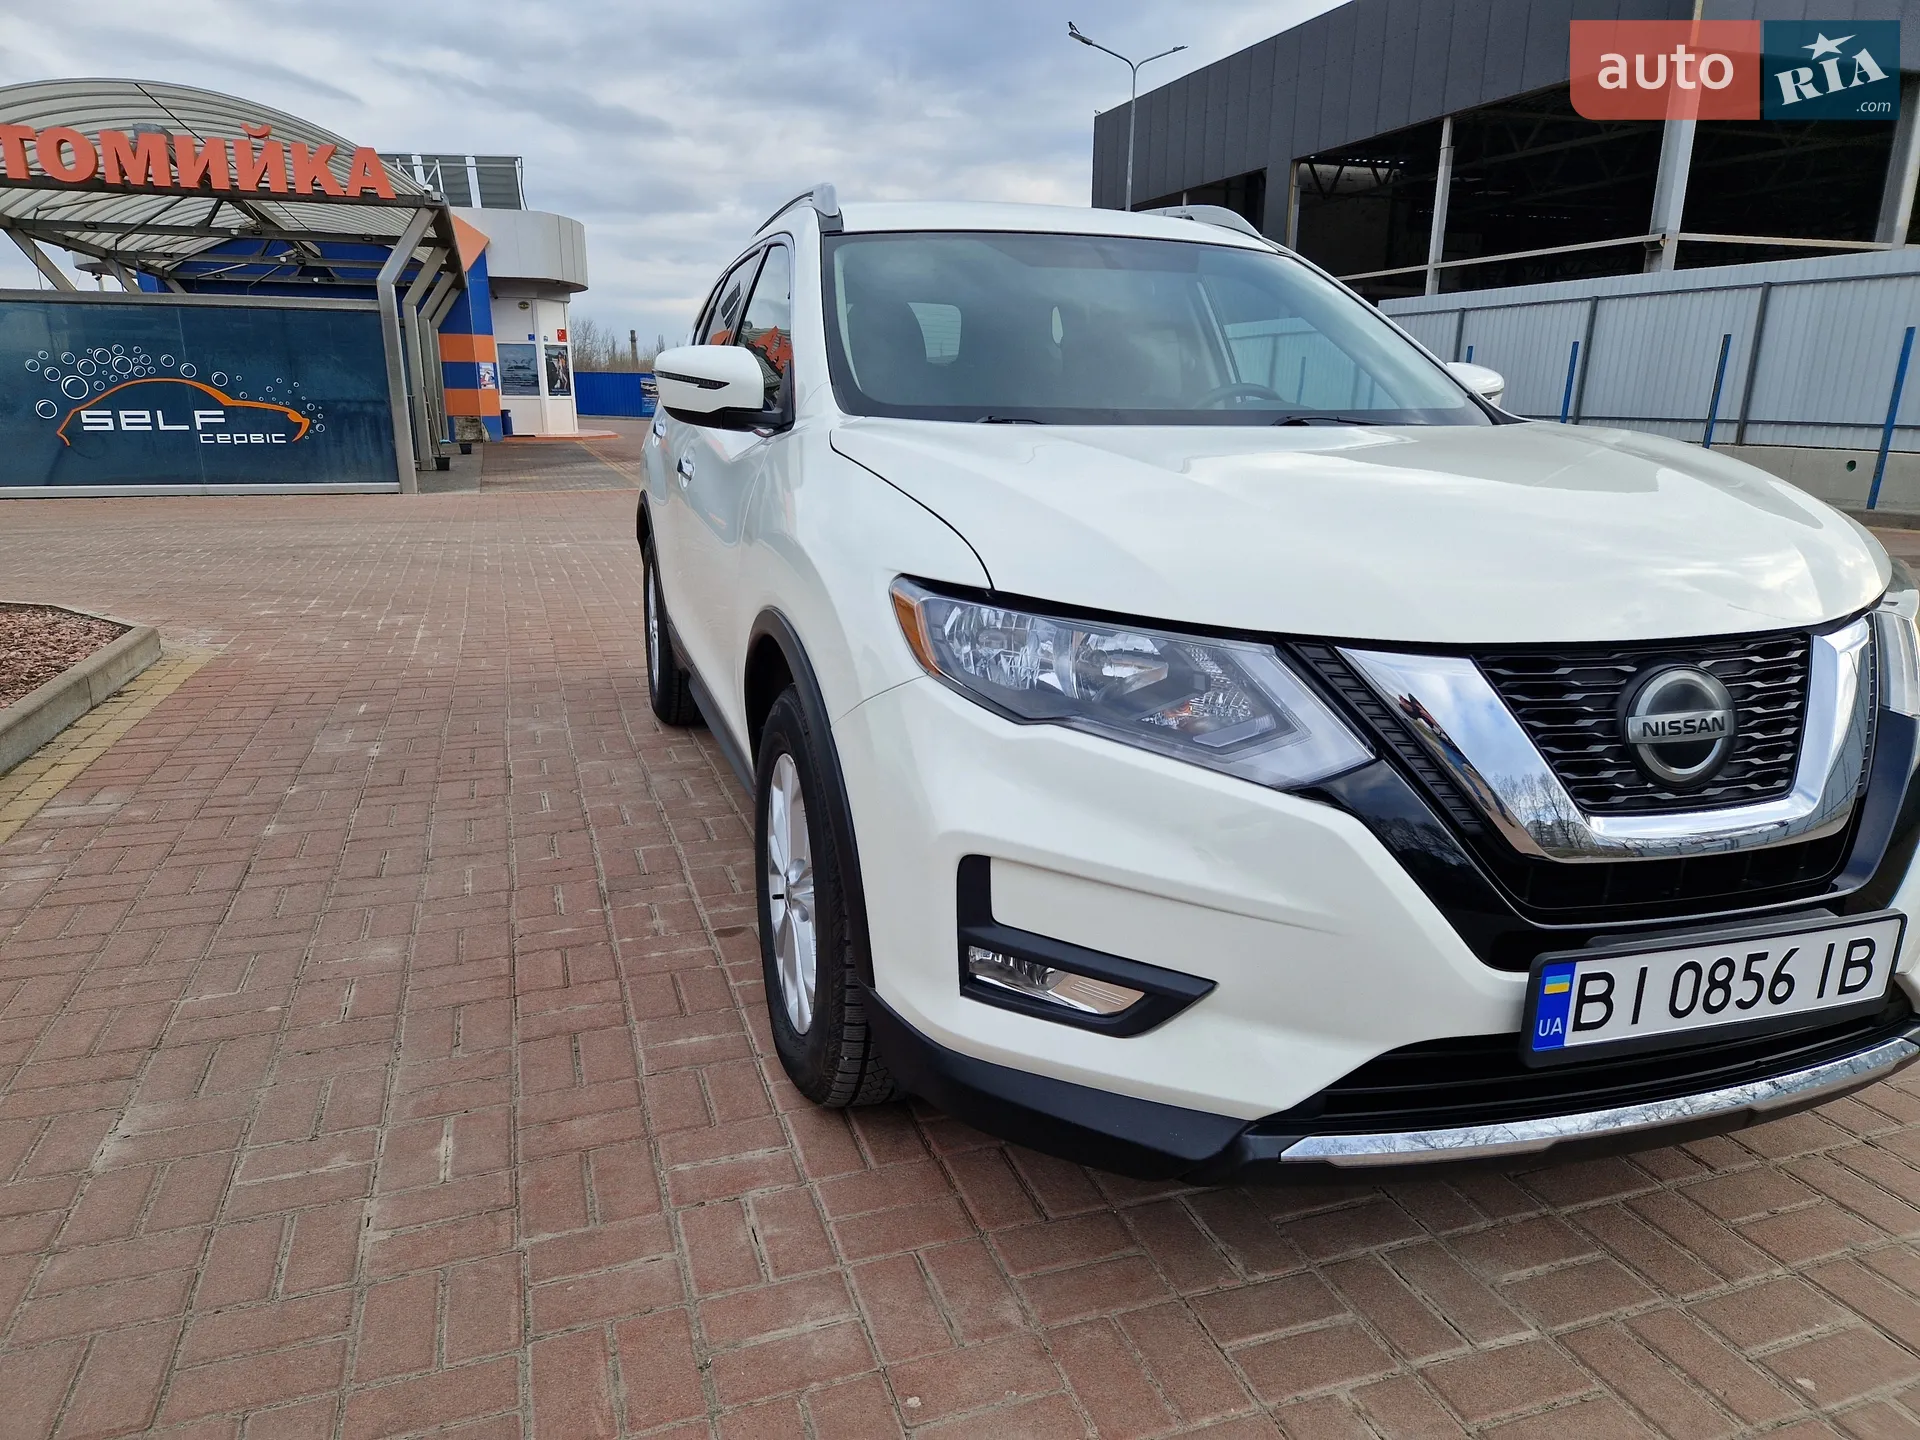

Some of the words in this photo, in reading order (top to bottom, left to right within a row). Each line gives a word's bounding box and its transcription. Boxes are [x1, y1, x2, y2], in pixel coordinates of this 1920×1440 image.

[1642, 716, 1726, 738] NISSAN
[1538, 1018, 1563, 1038] UA
[1571, 965, 1649, 1032] BI
[1668, 947, 1801, 1019] 0856
[1816, 937, 1877, 999] IB
